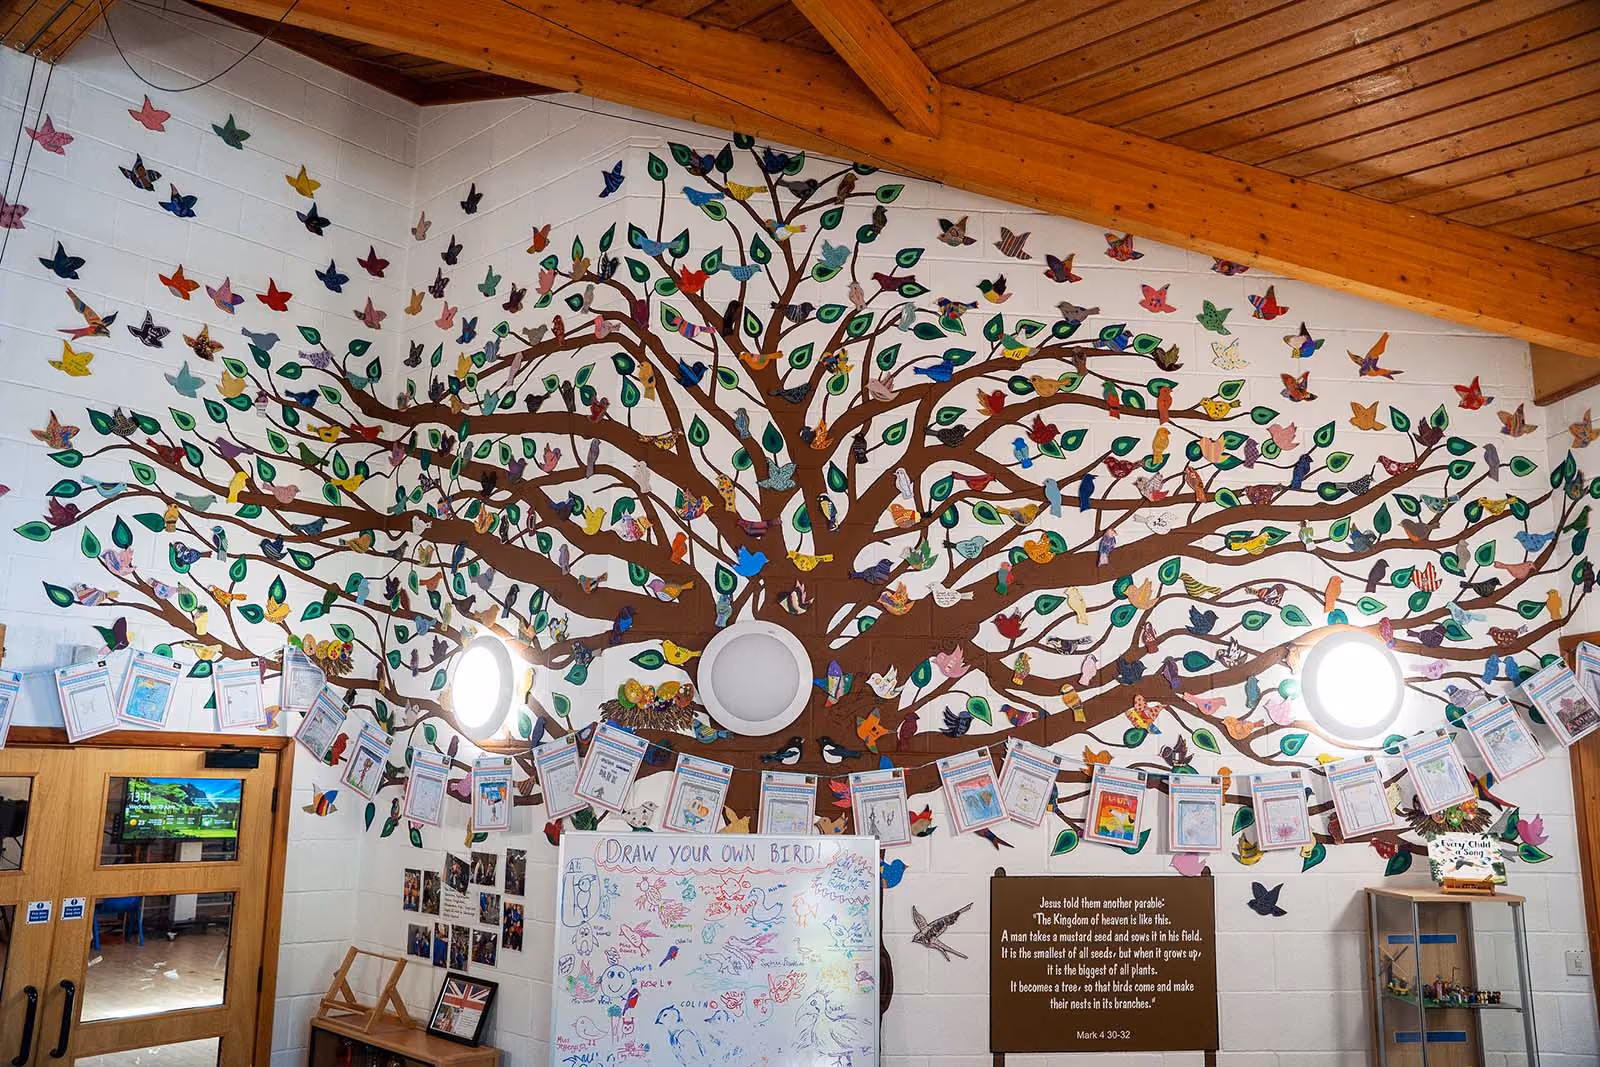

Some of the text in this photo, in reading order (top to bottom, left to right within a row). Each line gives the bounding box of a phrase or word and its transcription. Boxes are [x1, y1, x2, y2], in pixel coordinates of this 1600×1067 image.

[1441, 840, 1465, 850] Every
[606, 839, 822, 865] DRAW YOUR OWN BIRD!
[1463, 849, 1484, 858] Song
[1039, 897, 1165, 911] Jesus told them another parable:
[1053, 913, 1089, 928] Kingdom
[1090, 913, 1099, 925] of
[1101, 913, 1128, 925] heaven
[1130, 914, 1137, 925] is
[1138, 913, 1153, 924] like
[1154, 914, 1171, 925] this.
[1001, 930, 1009, 942] A
[1029, 930, 1051, 941] takes
[1059, 930, 1092, 941] mustard
[1094, 930, 1112, 941] seed
[1114, 930, 1129, 941] and
[1131, 933, 1150, 941] sows
[1151, 931, 1158, 941] it
[1159, 931, 1167, 942] in
[1168, 930, 1180, 941] his
[1181, 930, 1203, 941] field.
[1001, 947, 1008, 958] It
[1010, 948, 1017, 958] is
[1019, 947, 1032, 958] the
[1033, 947, 1066, 958] smallest
[1068, 947, 1077, 958] of
[1079, 947, 1089, 958] all
[1118, 947, 1131, 958] but
[1133, 947, 1154, 958] when
[1155, 948, 1162, 958] it
[1164, 950, 1187, 961] grows
[1047, 964, 1158, 978] it is the biggest of all plants.
[1010, 981, 1017, 992] It
[1019, 981, 1053, 992] becomes
[1054, 984, 1060, 992] a
[1084, 984, 1093, 992] so
[1094, 980, 1111, 992] that
[1112, 980, 1132, 992] birds
[1134, 984, 1155, 992] come
[1156, 980, 1171, 992] and
[1173, 980, 1194, 991] make
[680, 1000, 708, 1008] COLIN
[1050, 998, 1068, 1009] their
[1070, 999, 1092, 1009] nests
[1093, 998, 1100, 1009] in
[1102, 998, 1113, 1008] its
[1076, 1031, 1131, 1040] Mark 4 30-32
